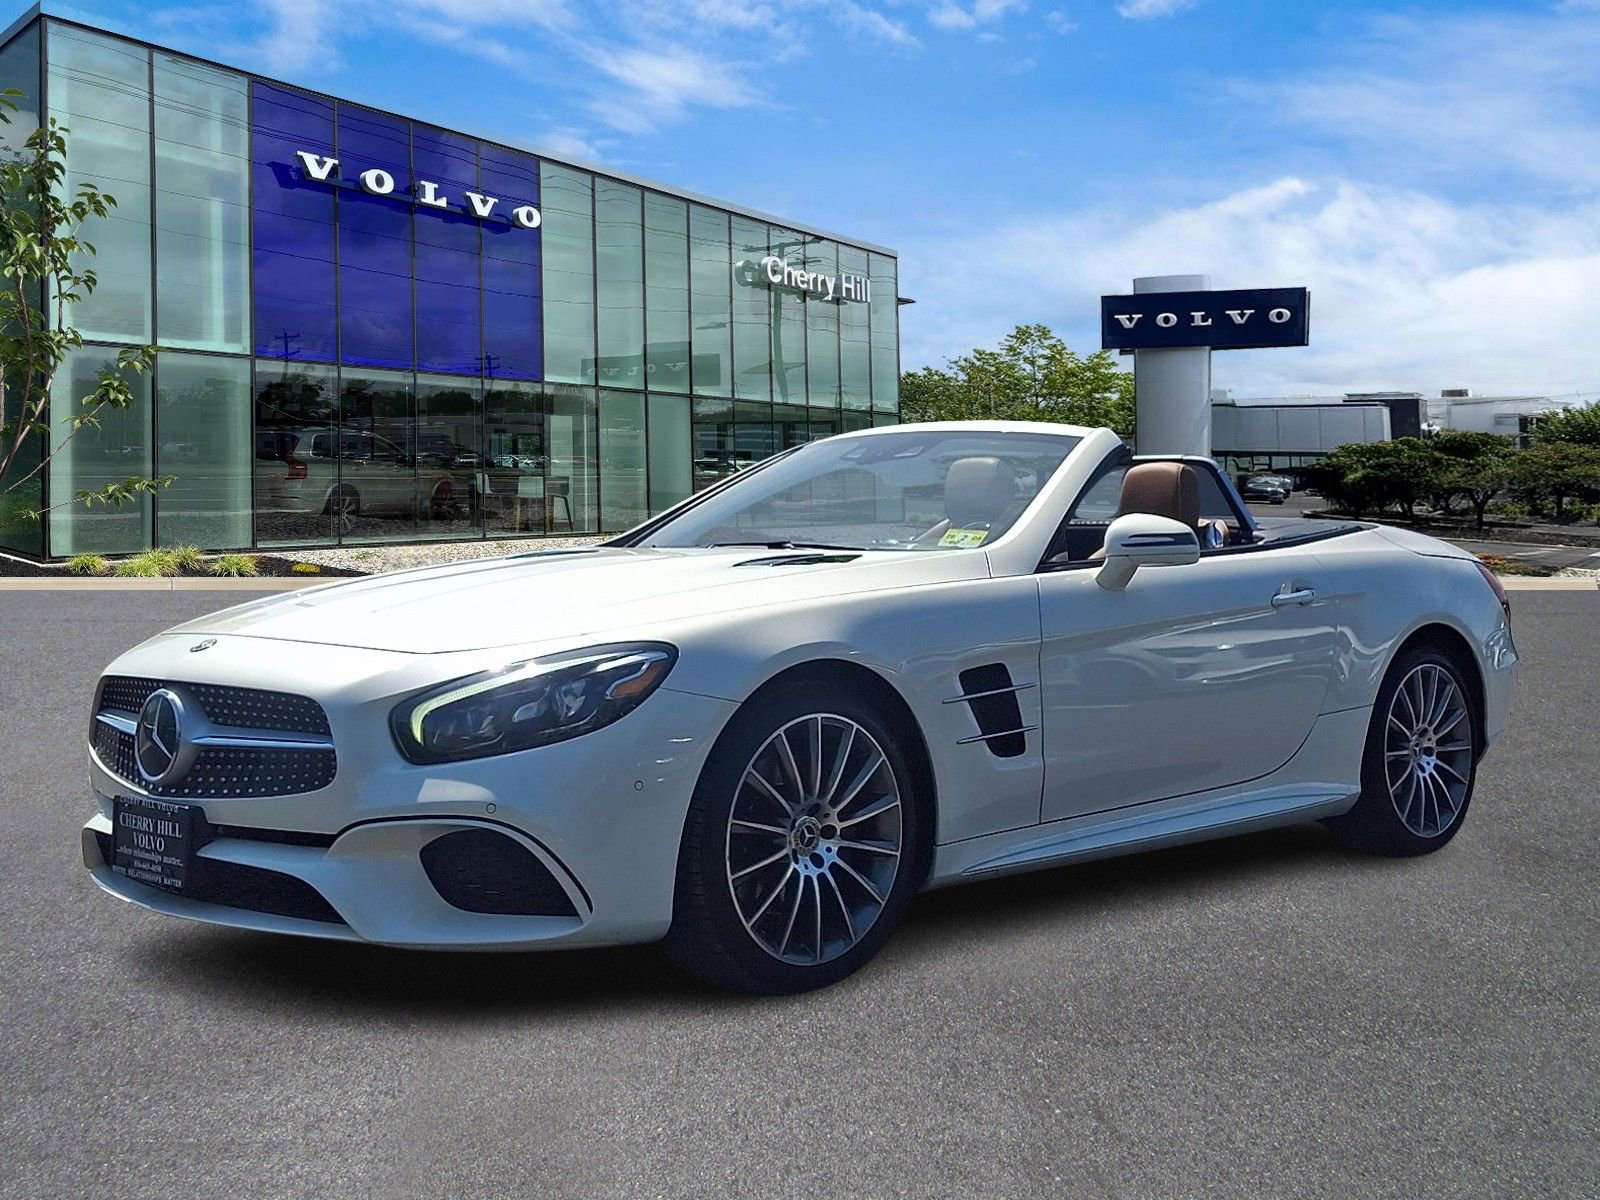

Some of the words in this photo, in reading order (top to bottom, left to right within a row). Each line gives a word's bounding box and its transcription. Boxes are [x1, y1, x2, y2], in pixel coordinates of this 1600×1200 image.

[296, 150, 541, 229] VOLVO
[762, 255, 835, 301] Cherry
[841, 273, 871, 302] Hill
[1114, 308, 1292, 329] VOLVO
[119, 811, 156, 833] CHERRY
[157, 820, 183, 838] HILL
[133, 832, 165, 852] VOLVO
